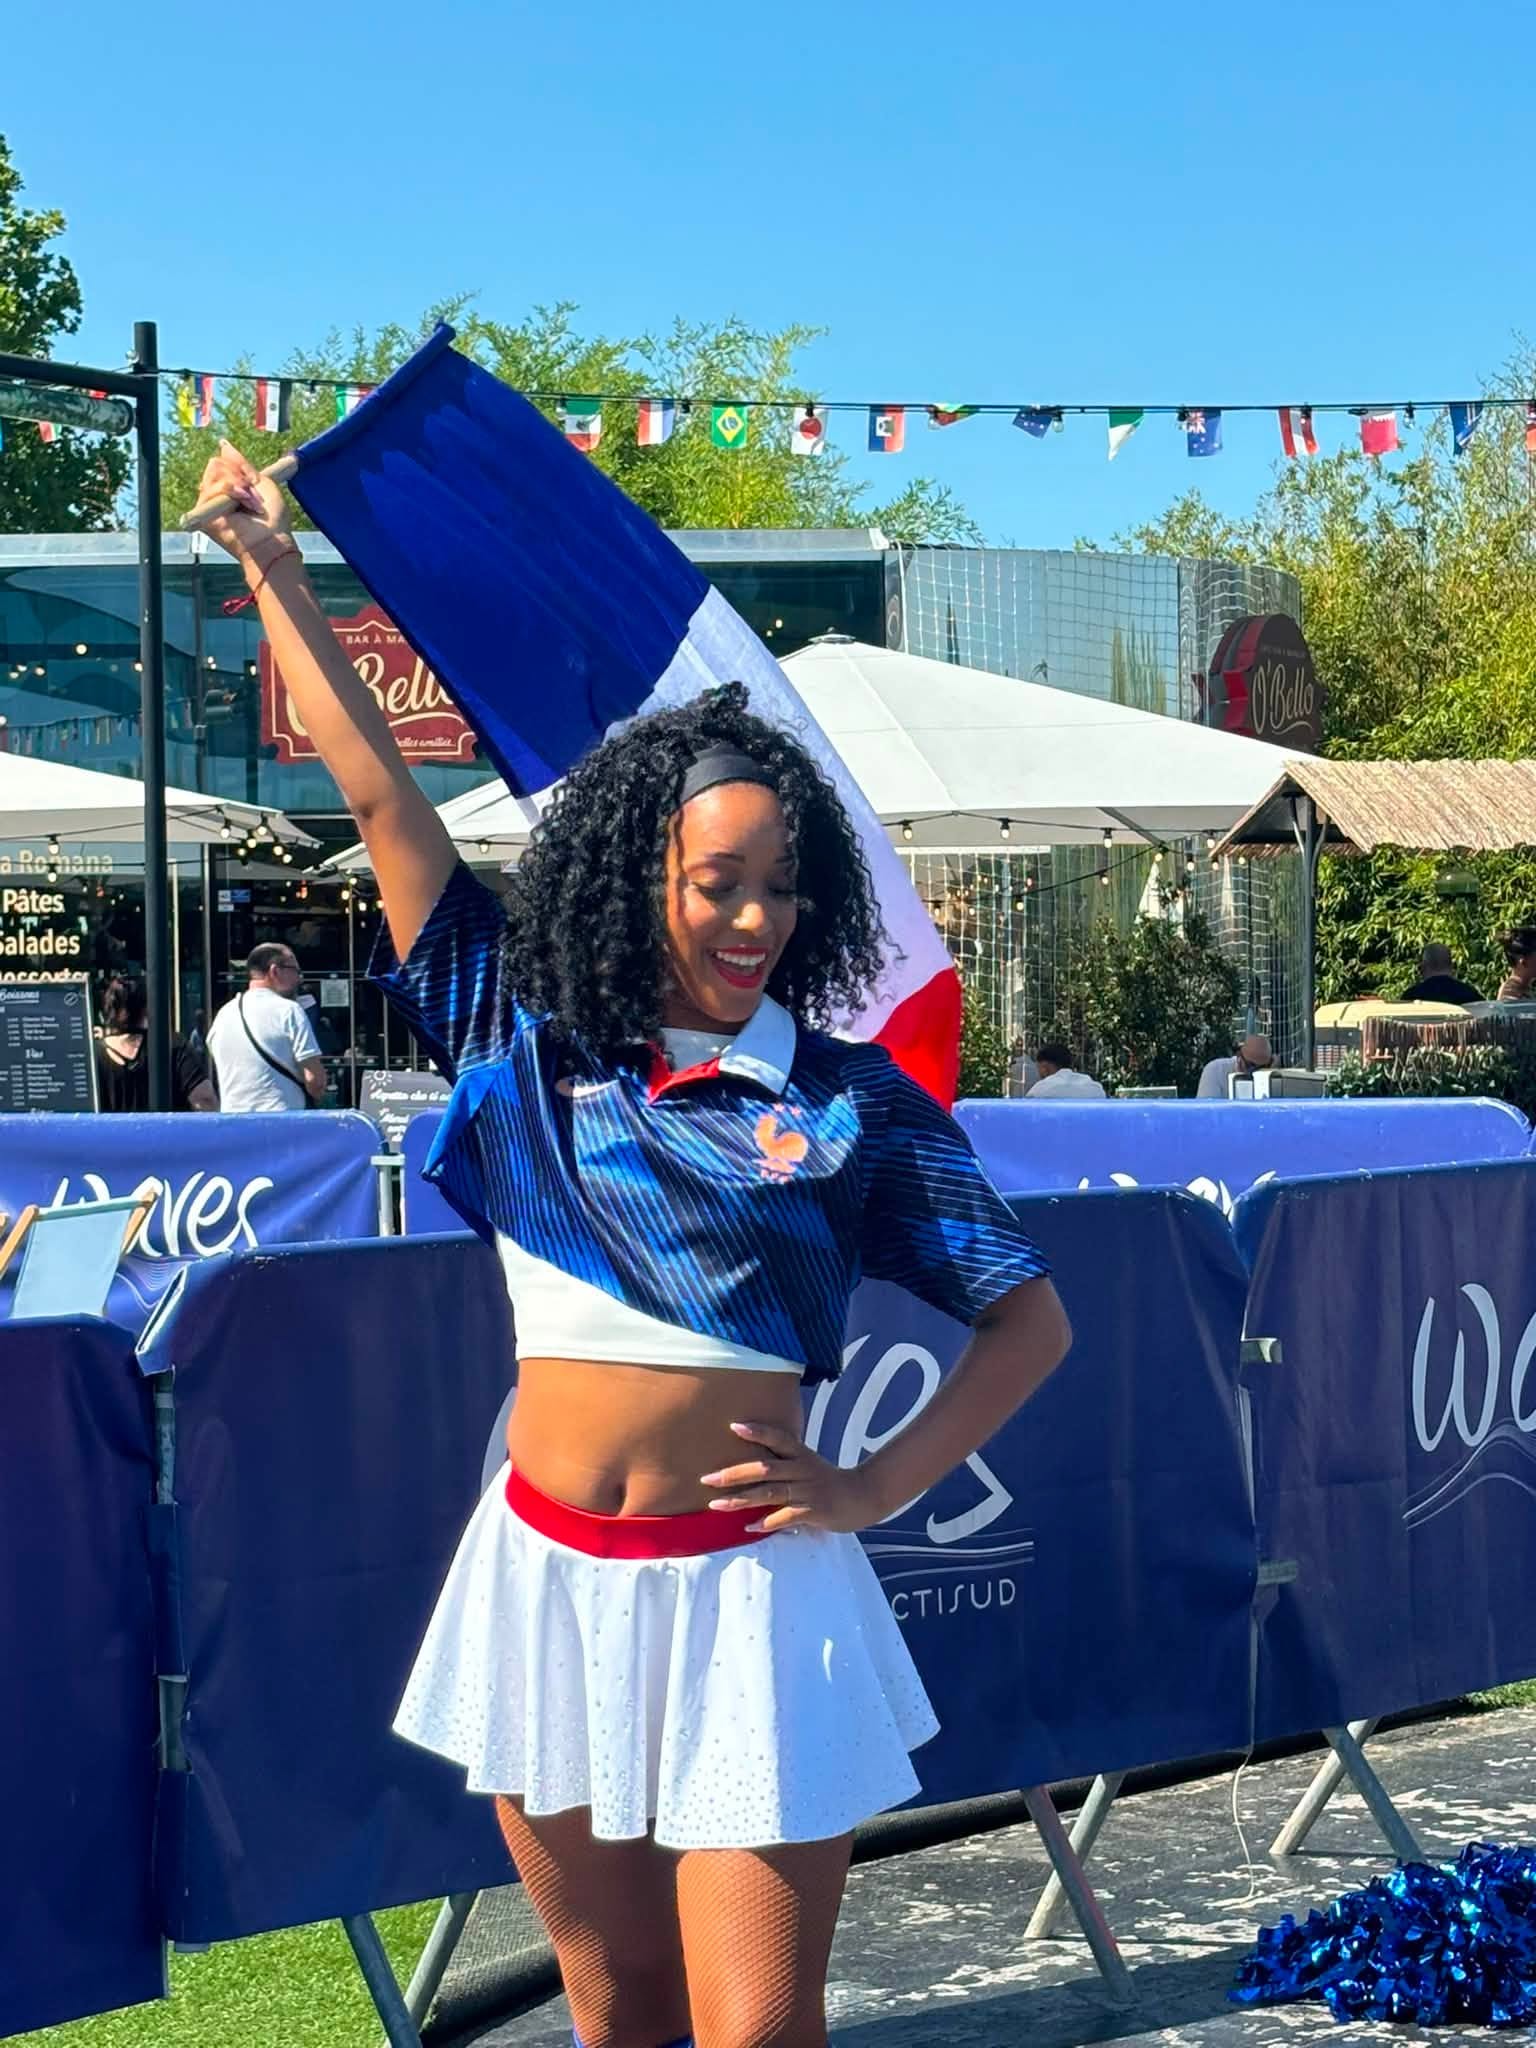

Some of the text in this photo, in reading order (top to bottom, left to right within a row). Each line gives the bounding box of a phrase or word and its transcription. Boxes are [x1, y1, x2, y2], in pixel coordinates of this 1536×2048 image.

[346, 634, 369, 645] BAR
[1252, 658, 1314, 735] O'Bello
[3, 888, 66, 913] Pâtes
